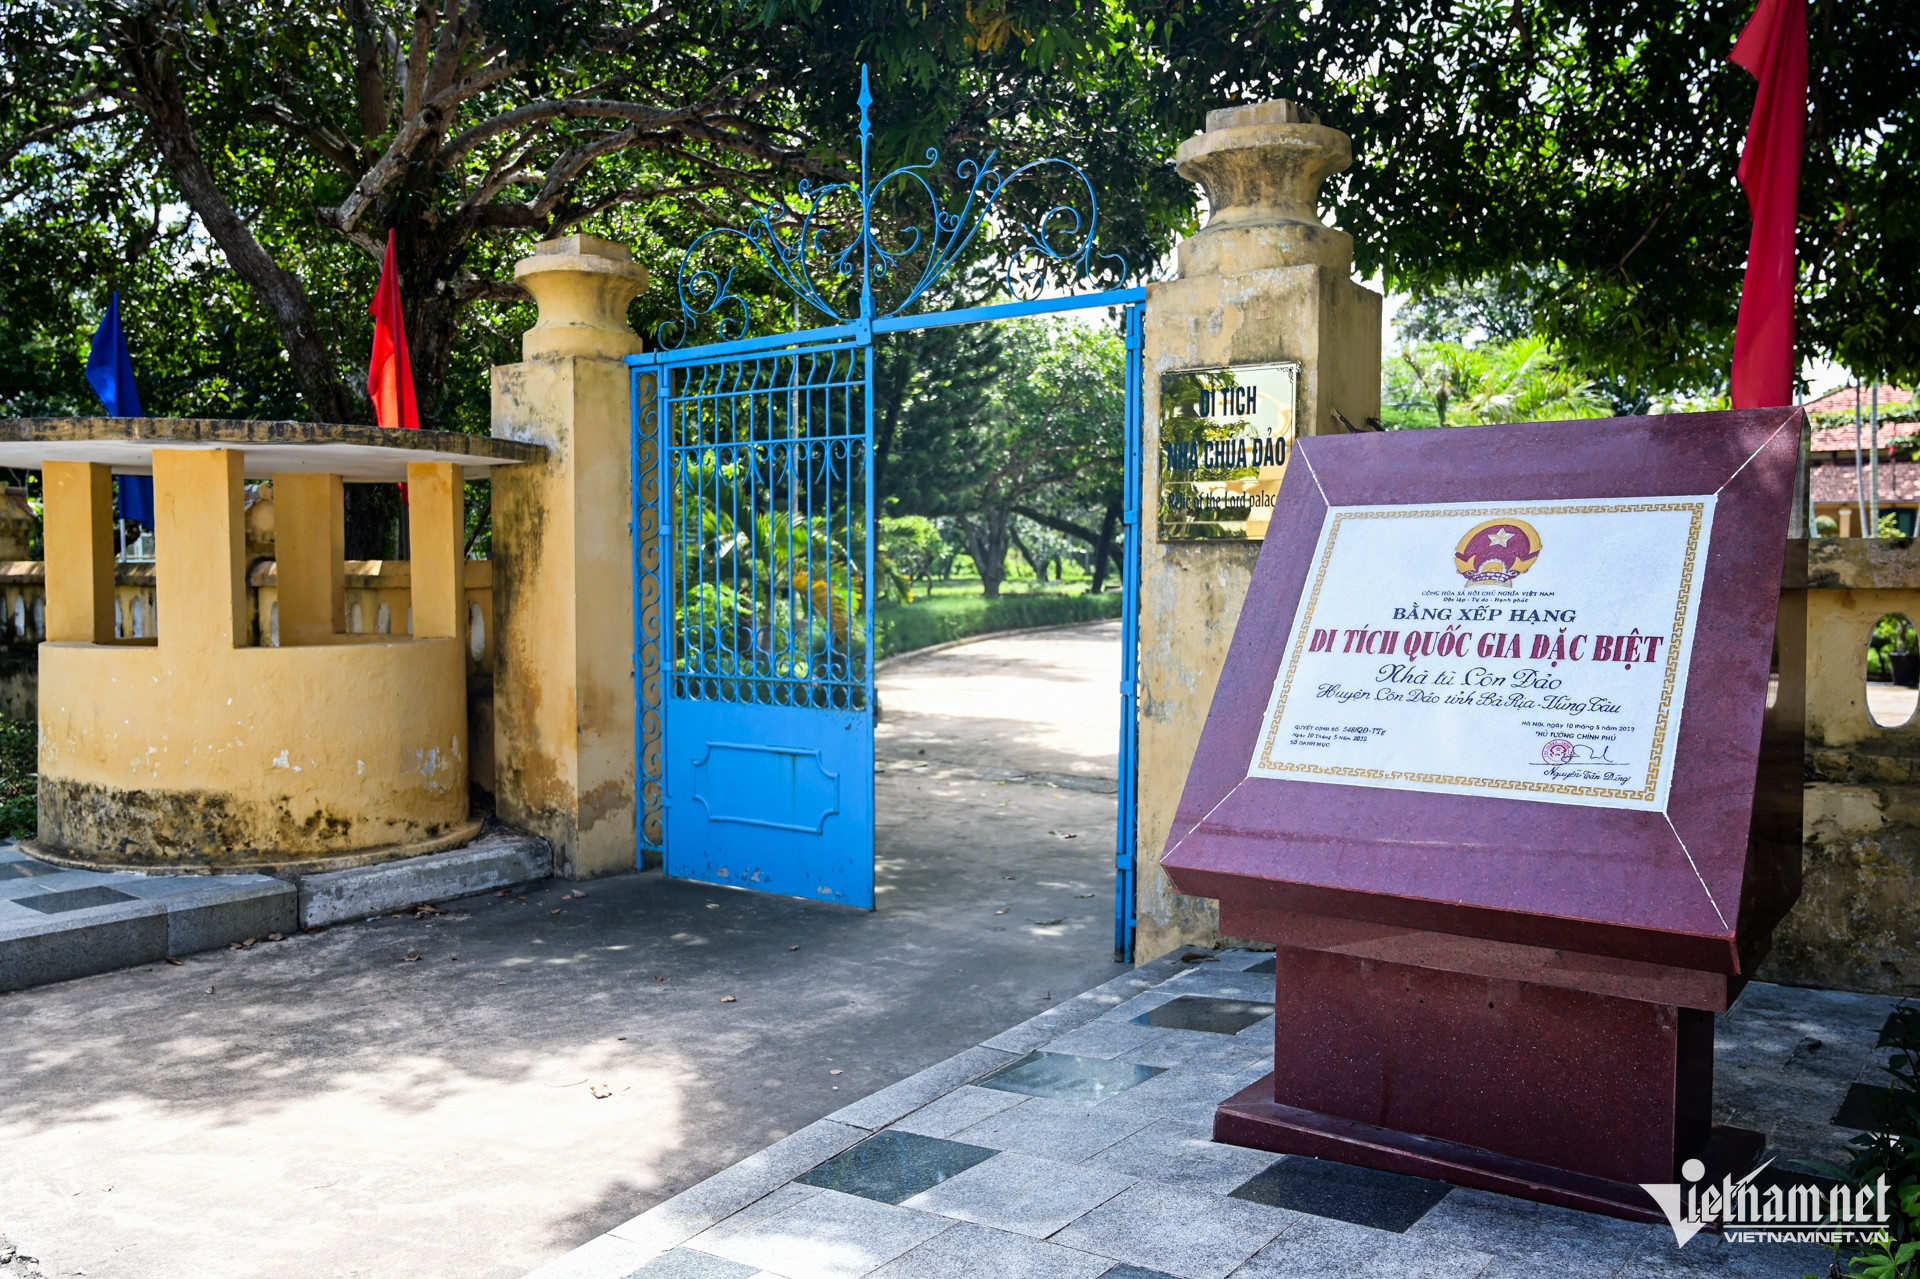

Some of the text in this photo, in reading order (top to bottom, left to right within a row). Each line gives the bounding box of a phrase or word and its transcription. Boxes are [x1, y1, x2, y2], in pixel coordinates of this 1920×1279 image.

[1200, 381, 1257, 418] DI TÍCH
[1167, 427, 1286, 471] NHÀ CHÚA ĐẢO
[1169, 489, 1276, 512] Relic of the Lord palac
[1481, 589, 1496, 597] CHỦ
[1391, 602, 1577, 626] BẰNG XẾP HẠNG
[1308, 624, 1664, 671] DI TÍCH QUỐC GIA ĐẶC BIỆT
[1375, 663, 1562, 690] Nhà tù Côn Đảo
[1316, 683, 1371, 704] Huyện
[1373, 687, 1404, 702] Côn
[1444, 690, 1476, 706] tỉnh
[1587, 697, 1621, 714] Tàu
[1574, 723, 1595, 731] tháng
[1576, 732, 1600, 740] CHÍNH
[1600, 733, 1617, 741] PHỦ
[1543, 766, 1581, 780] Nguyễn
